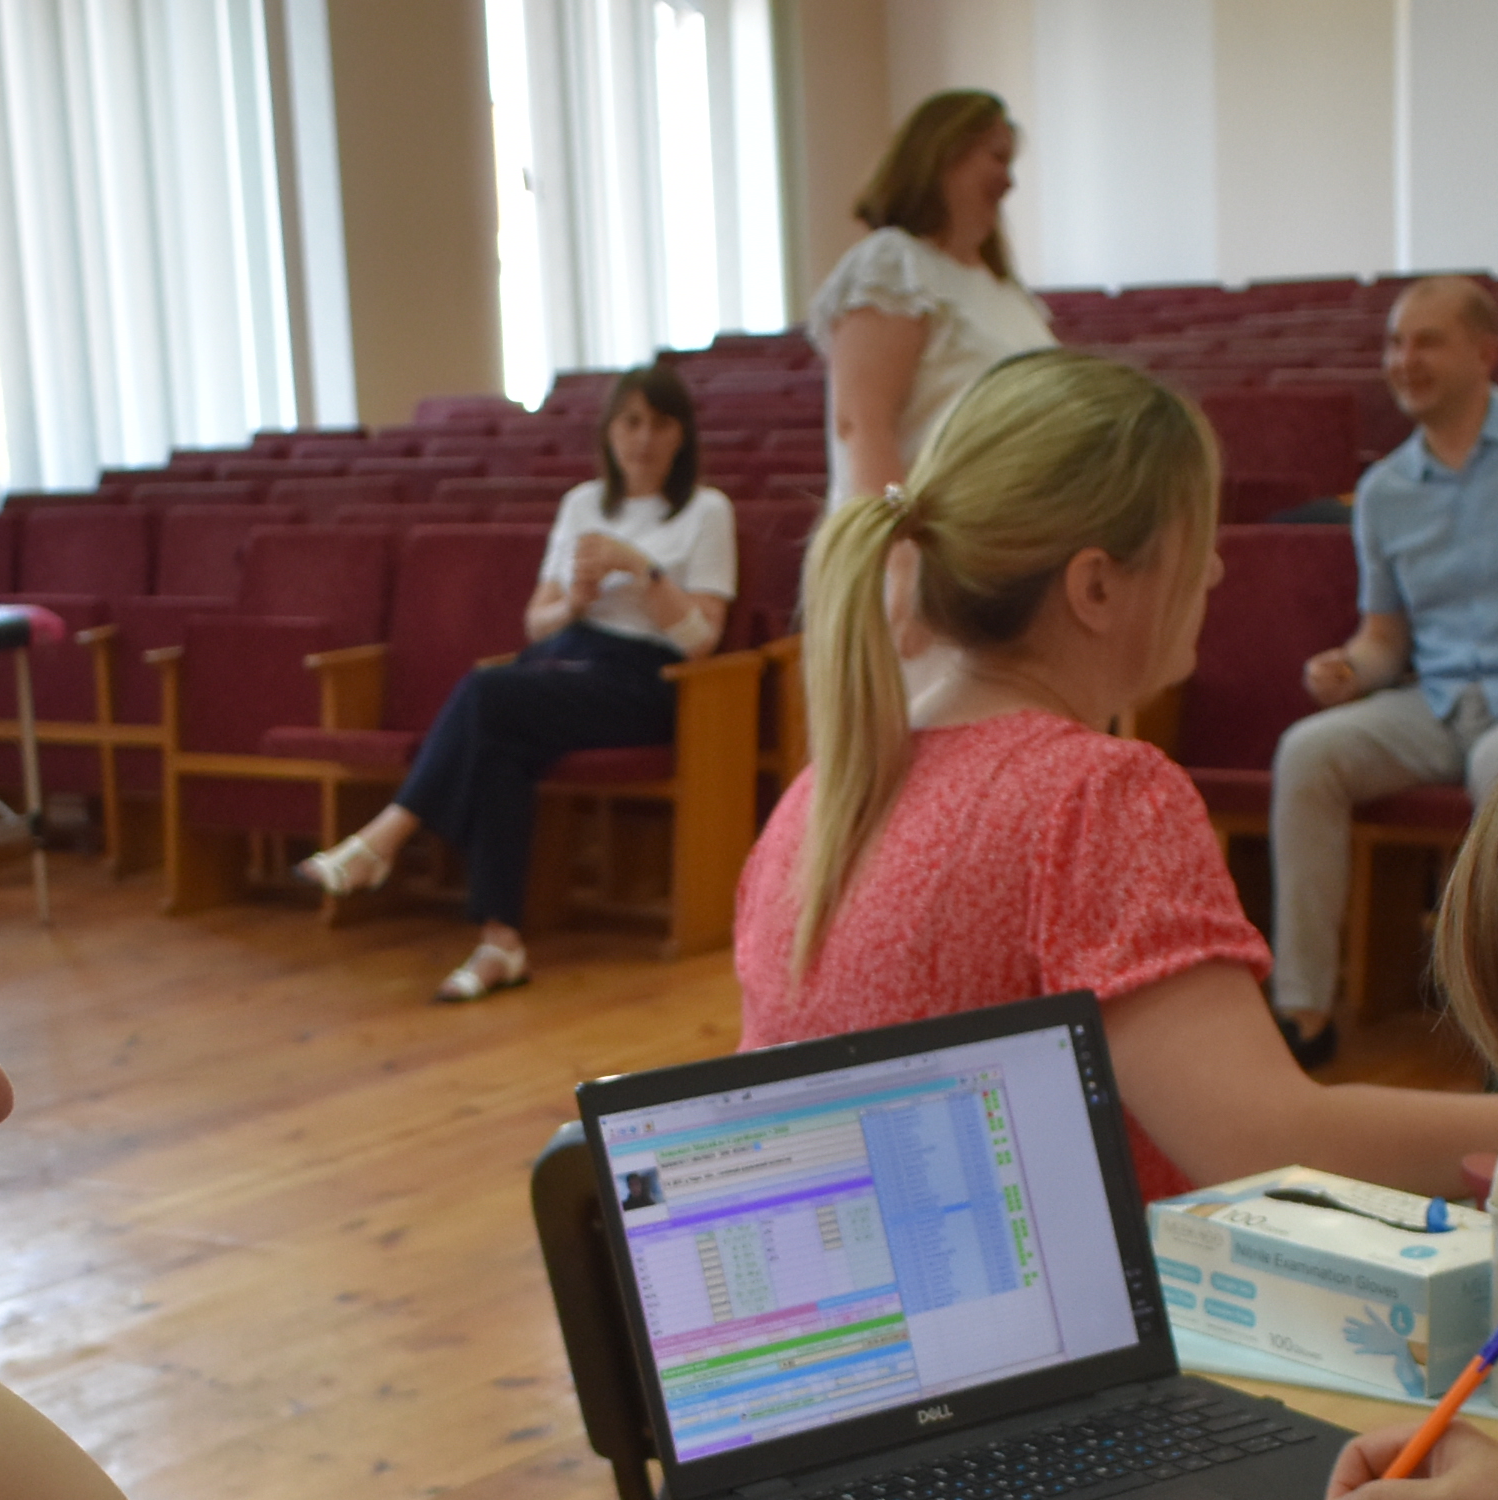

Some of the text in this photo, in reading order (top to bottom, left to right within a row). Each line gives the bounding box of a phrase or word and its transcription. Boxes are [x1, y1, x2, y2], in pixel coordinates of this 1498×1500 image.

[1274, 1252, 1353, 1286] Examination
[1355, 1273, 1400, 1300] Gloves
[917, 1404, 954, 1426] DELL
